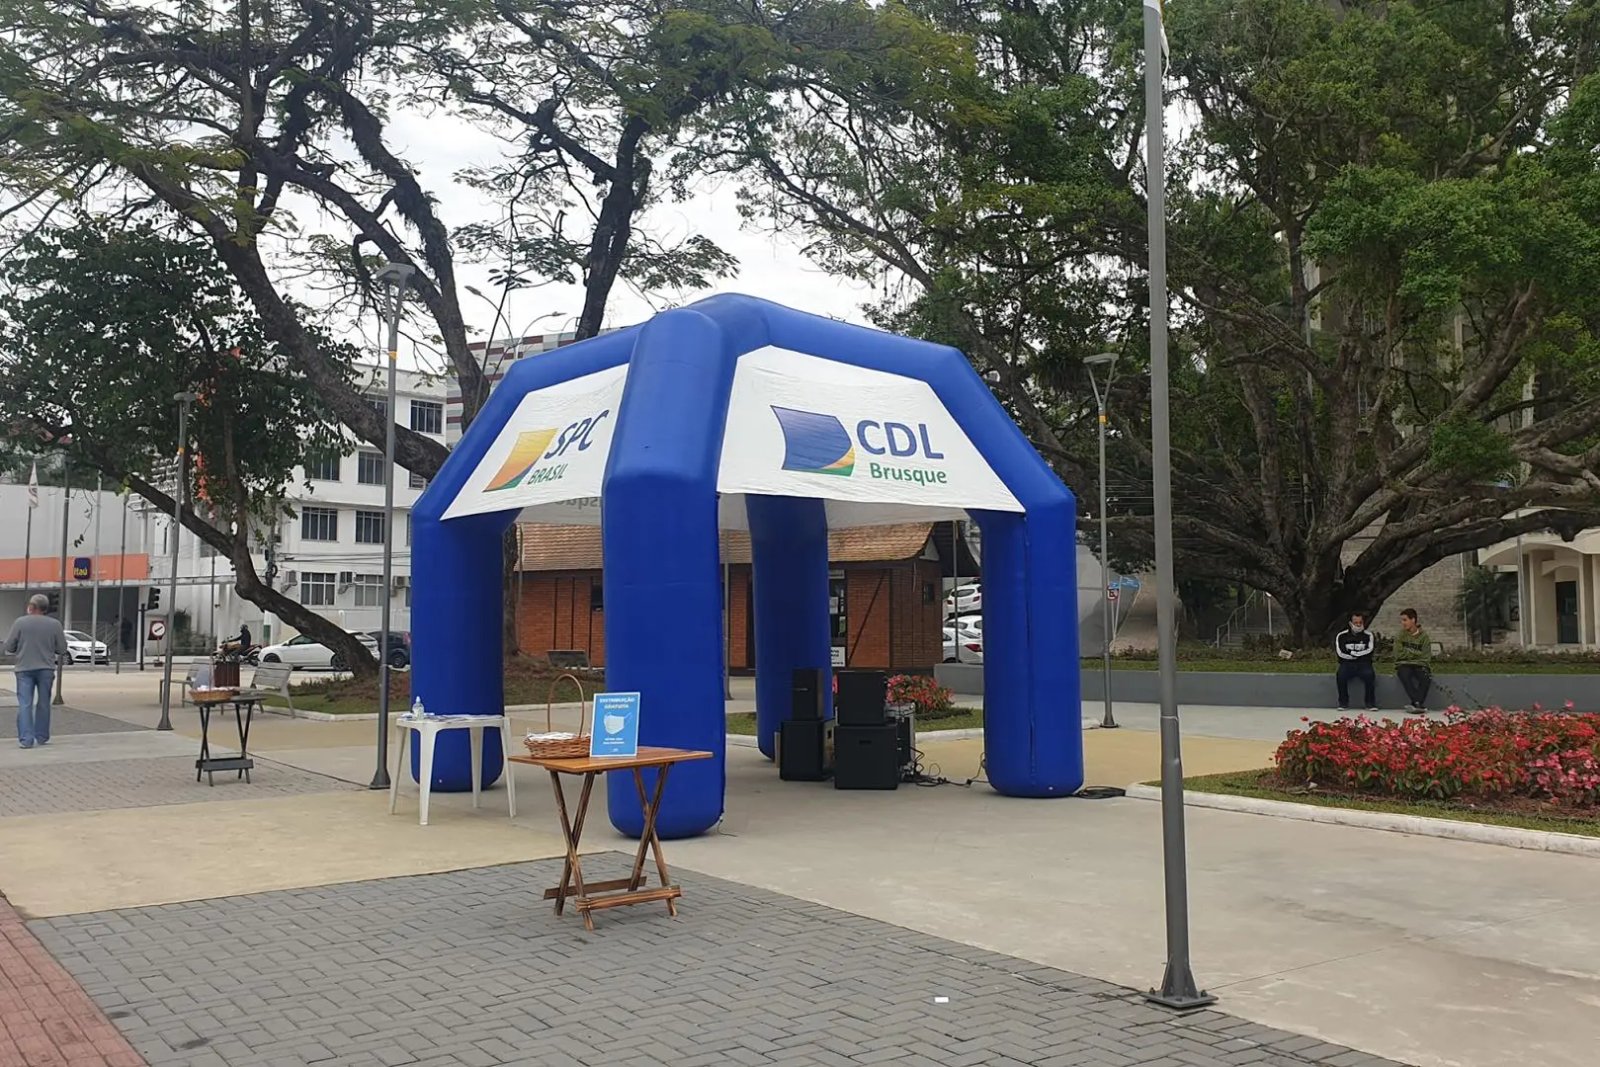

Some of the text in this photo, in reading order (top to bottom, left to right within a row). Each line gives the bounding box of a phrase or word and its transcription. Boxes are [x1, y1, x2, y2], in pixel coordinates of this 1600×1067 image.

[544, 409, 609, 459] SPC
[856, 419, 944, 459] CDL
[527, 463, 568, 485] BRASIL
[869, 462, 947, 486] Brusque
